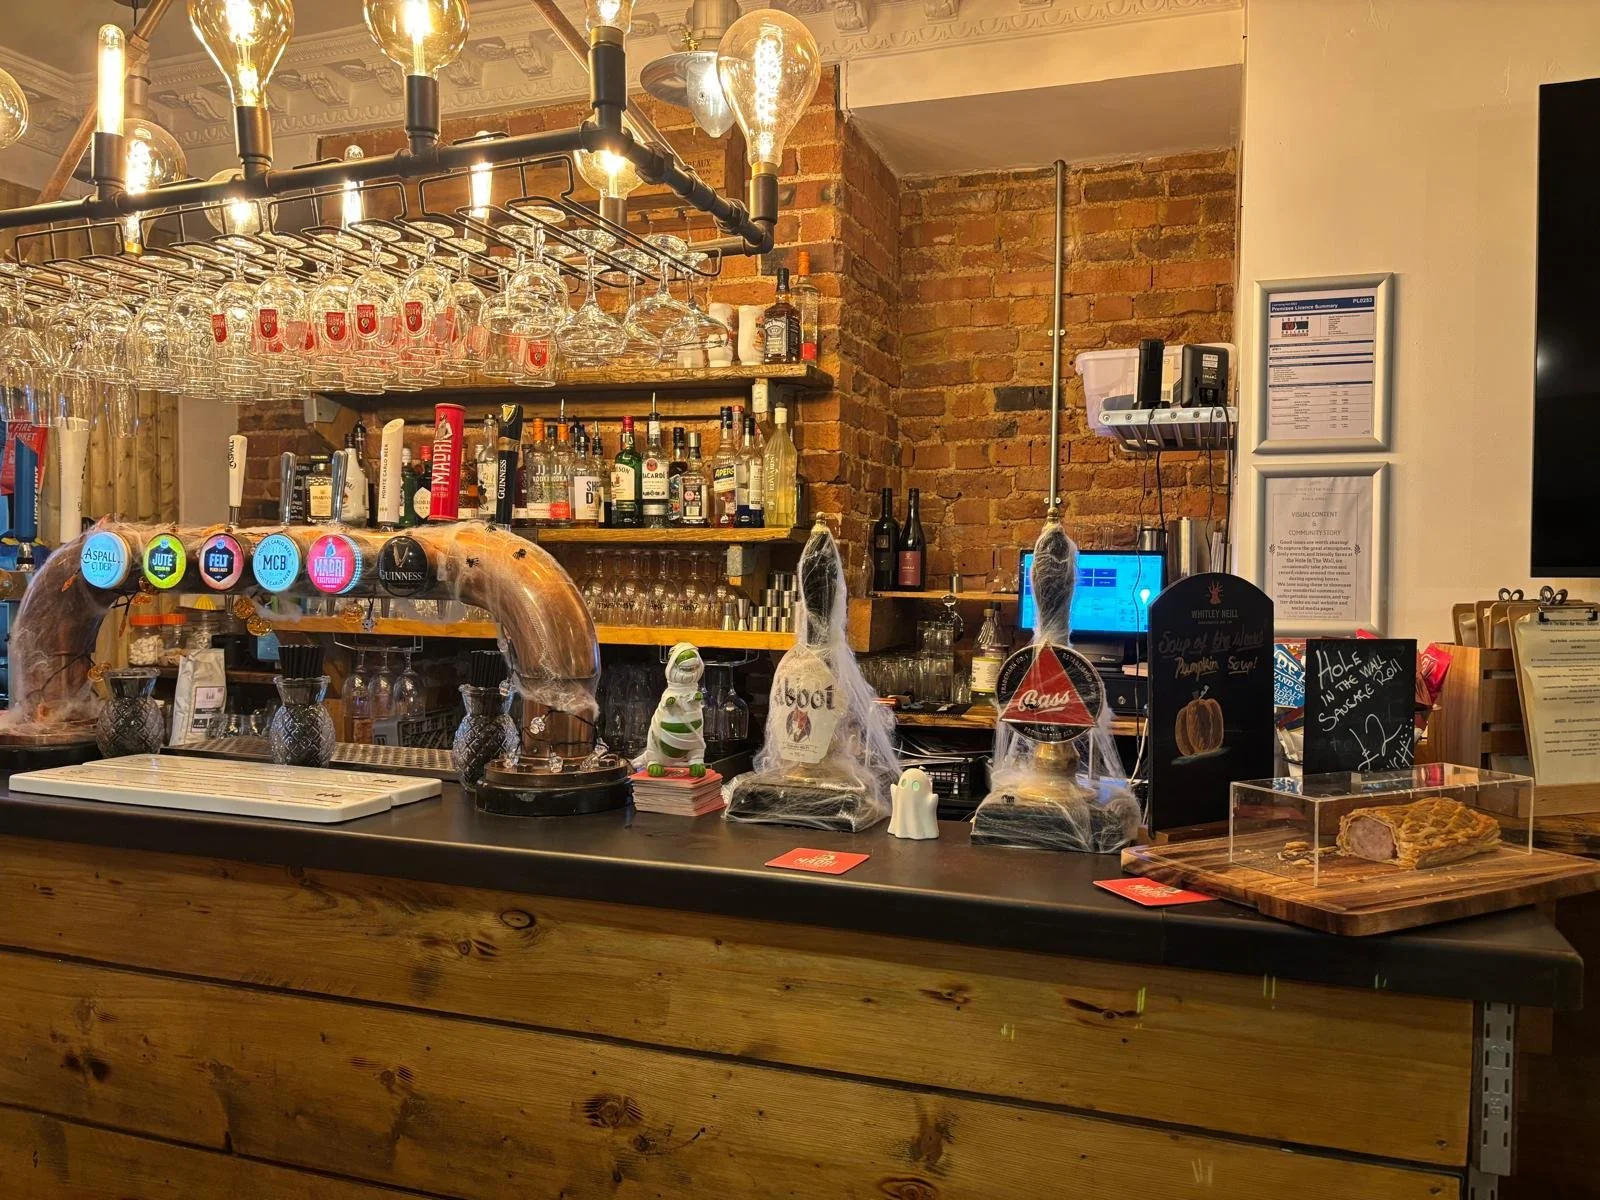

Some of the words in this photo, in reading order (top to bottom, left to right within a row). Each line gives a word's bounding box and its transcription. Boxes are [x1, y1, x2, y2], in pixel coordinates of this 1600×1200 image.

[498, 459, 507, 499] GUINNESS
[82, 548, 117, 564] ASPALL
[152, 553, 173, 567] JUTE
[209, 553, 229, 567] FELT
[262, 555, 287, 571] MCB
[380, 570, 423, 581] GUINNESS
[1191, 608, 1220, 619] WHITLEY
[1221, 608, 1239, 618] NEILL
[1062, 652, 1092, 682] ESTABLISHED
[1174, 656, 1219, 680] Pumpkin
[1315, 650, 1362, 690] HOLE
[1321, 690, 1335, 707] IN
[1335, 675, 1359, 691] THE
[1359, 655, 1386, 678] WALL
[1018, 690, 1071, 712] Bass
[1318, 683, 1375, 732] SAUSAGE
